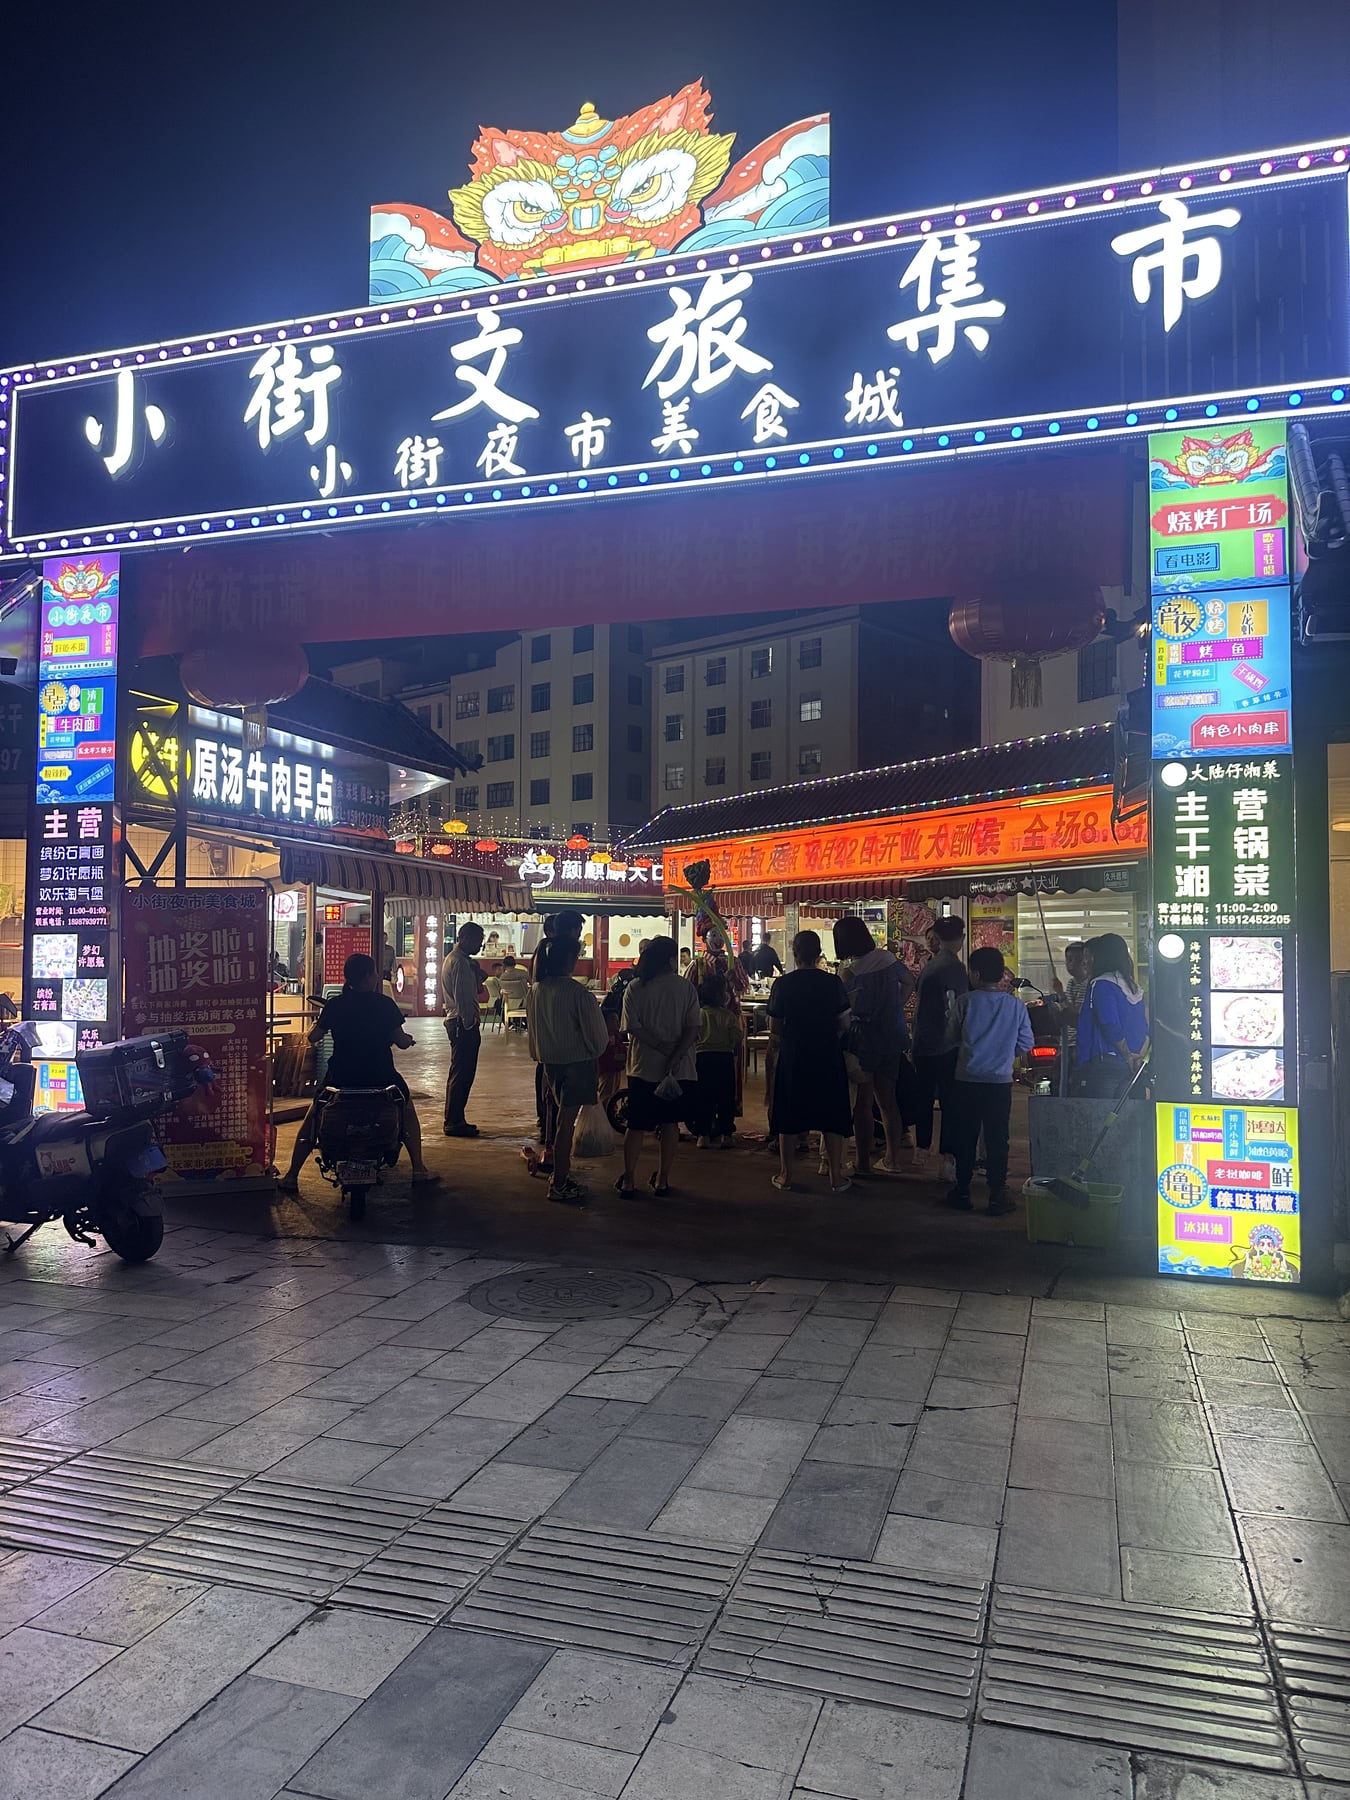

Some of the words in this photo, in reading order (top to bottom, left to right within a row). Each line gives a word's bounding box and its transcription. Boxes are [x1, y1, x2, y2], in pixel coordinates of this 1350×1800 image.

[86, 198, 1241, 475] 小街文旅集市
[311, 367, 905, 497] 小街夜市美食城
[1167, 502, 1272, 534] 烧烤广场
[1164, 551, 1211, 569] 看电影
[1261, 532, 1275, 575] 歌手驻唱
[50, 604, 111, 626] 小街夜市
[1159, 602, 1197, 634] 宵夜
[1241, 603, 1254, 636] 小龙虾
[43, 632, 54, 656] 划算
[1198, 642, 1246, 659] 烤鱼
[60, 717, 96, 732] 牛肉面
[1199, 721, 1279, 738] 特色小肉串
[192, 738, 334, 824] 原汤牛肉早点
[1188, 759, 1281, 781] 大陆仔湘菜
[1174, 788, 1268, 822] 主营
[43, 807, 103, 839] 主营
[1175, 826, 1270, 860] 干锅
[40, 865, 104, 881] 梦幻许愿瓶
[1174, 863, 1270, 898] 湘菜
[40, 886, 104, 901] 欢乐淘气堡
[133, 893, 257, 911] 小街夜市美食城
[1157, 903, 1209, 914] 营业时间：
[1215, 903, 1278, 913] 11:00-2:00
[1215, 914, 1291, 925] 15912452205
[146, 927, 255, 965] 抽奖啦！
[148, 956, 256, 994] 抽奖啦！
[134, 1007, 258, 1025] 参与抽奖活动商家名单
[1166, 1170, 1202, 1205] 撸串
[1271, 1167, 1294, 1188] 鲜
[1183, 1220, 1224, 1236] 冰淇淋
